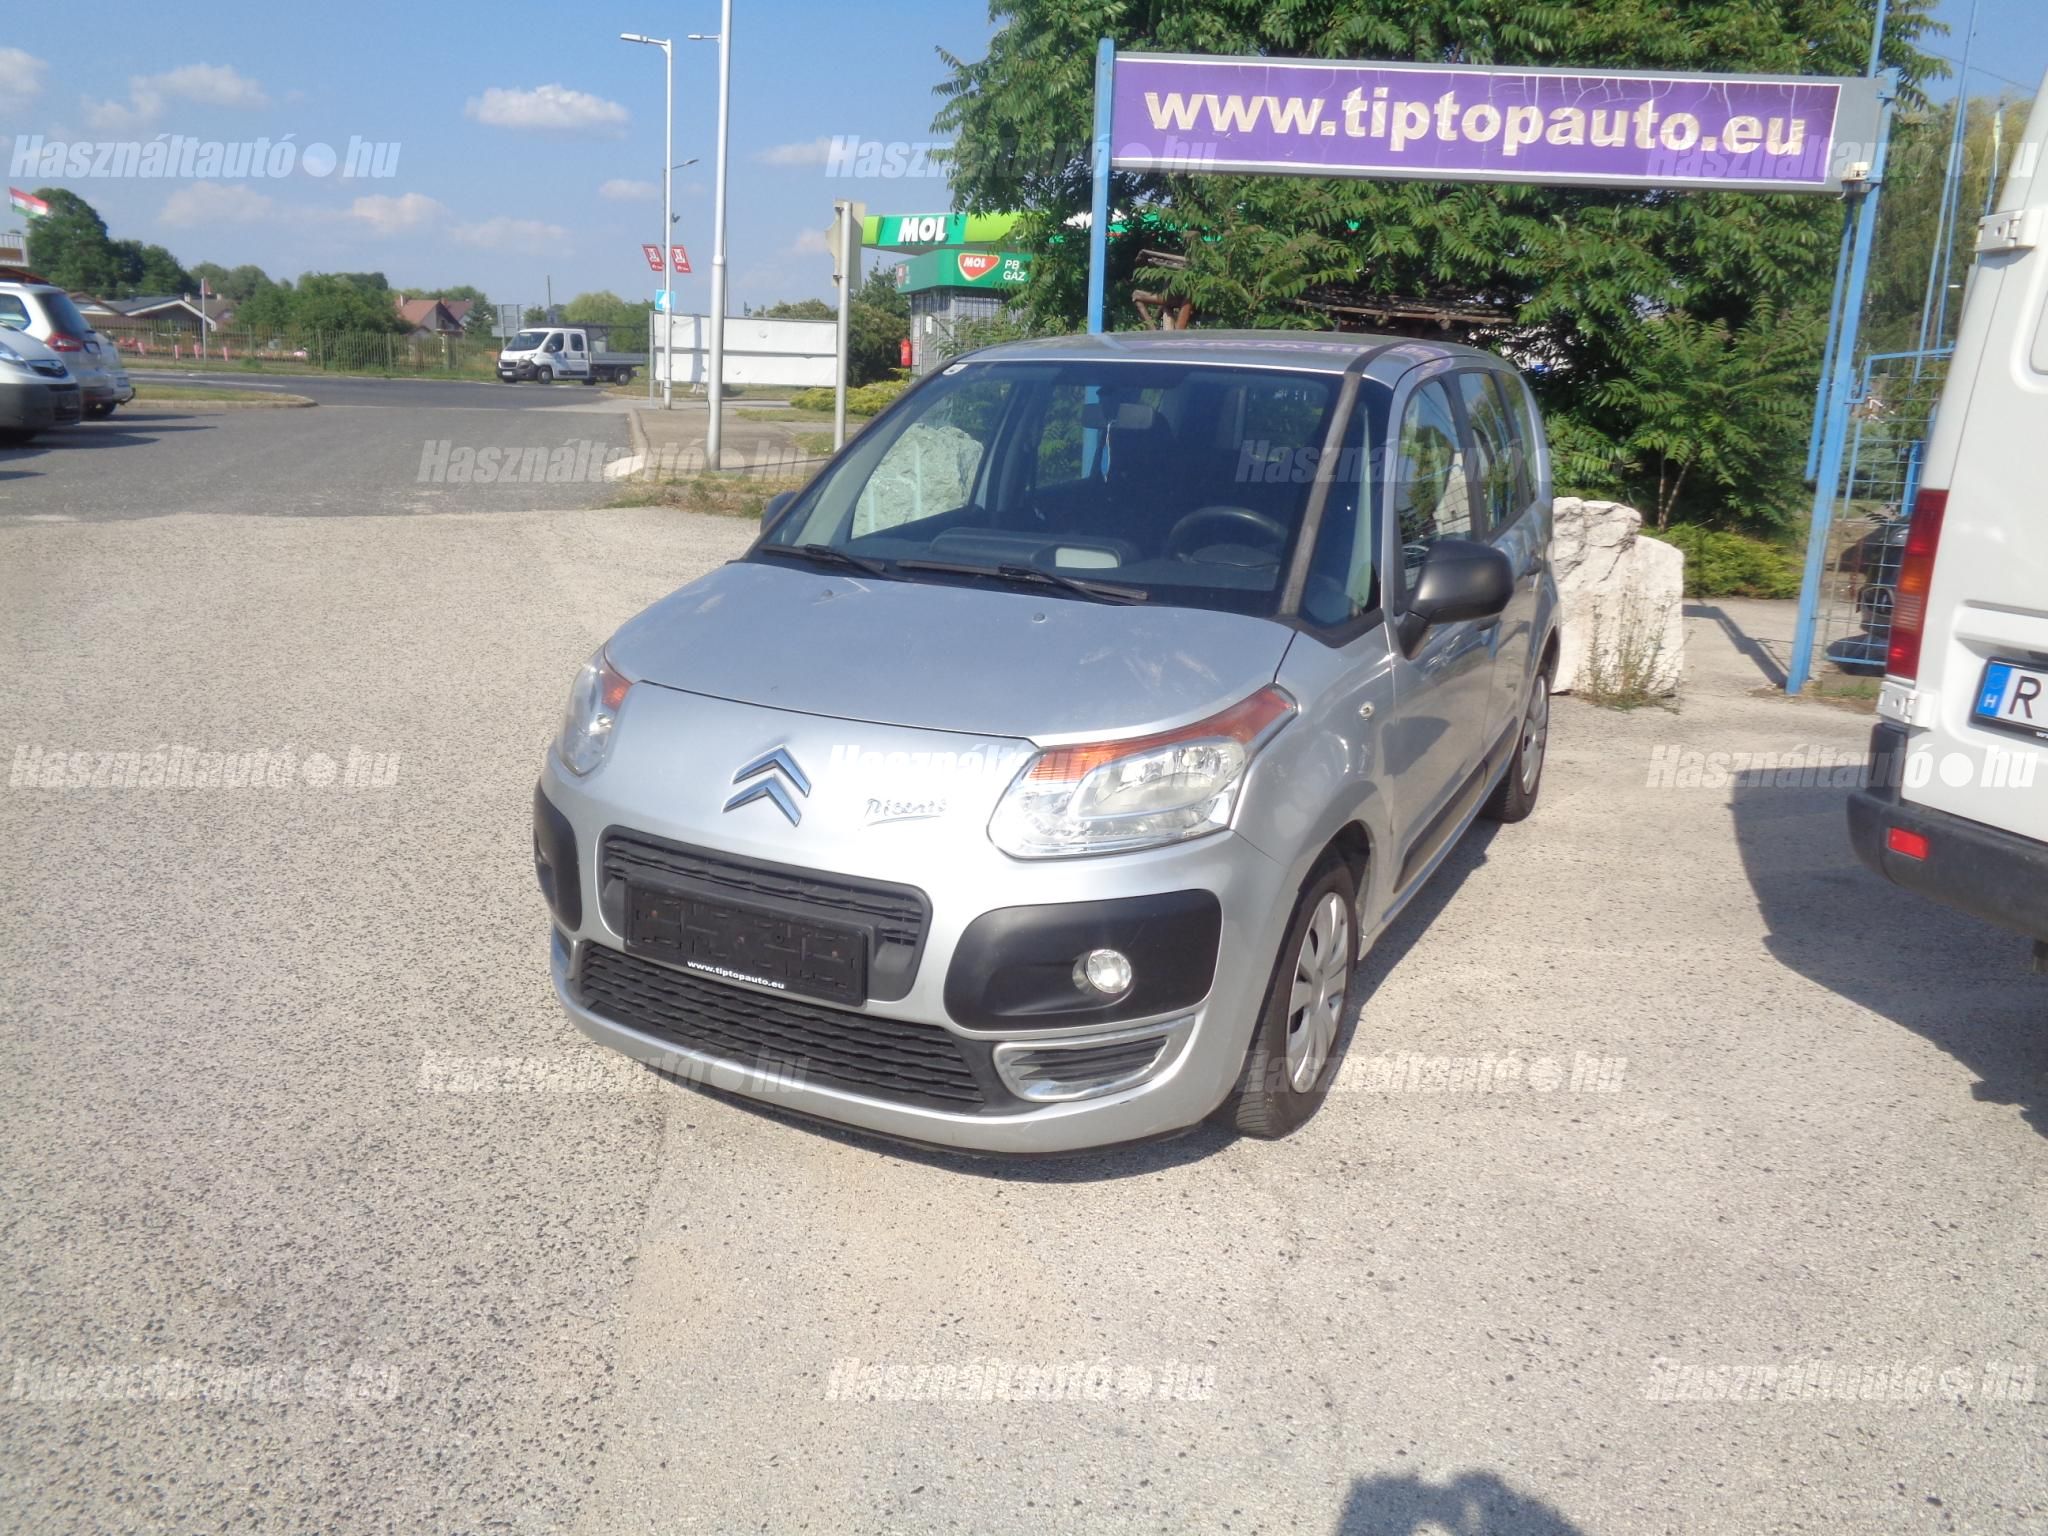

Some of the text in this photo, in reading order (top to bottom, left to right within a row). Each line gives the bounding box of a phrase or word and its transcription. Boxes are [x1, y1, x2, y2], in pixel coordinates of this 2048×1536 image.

[1144, 85, 1806, 157] www.tiptopauto.eu
[897, 216, 948, 243] MOL
[963, 257, 988, 268] MOL
[1004, 260, 1020, 270] PB
[1983, 675, 2042, 719] H R
[687, 960, 785, 990] www.tiptopauto.eu
